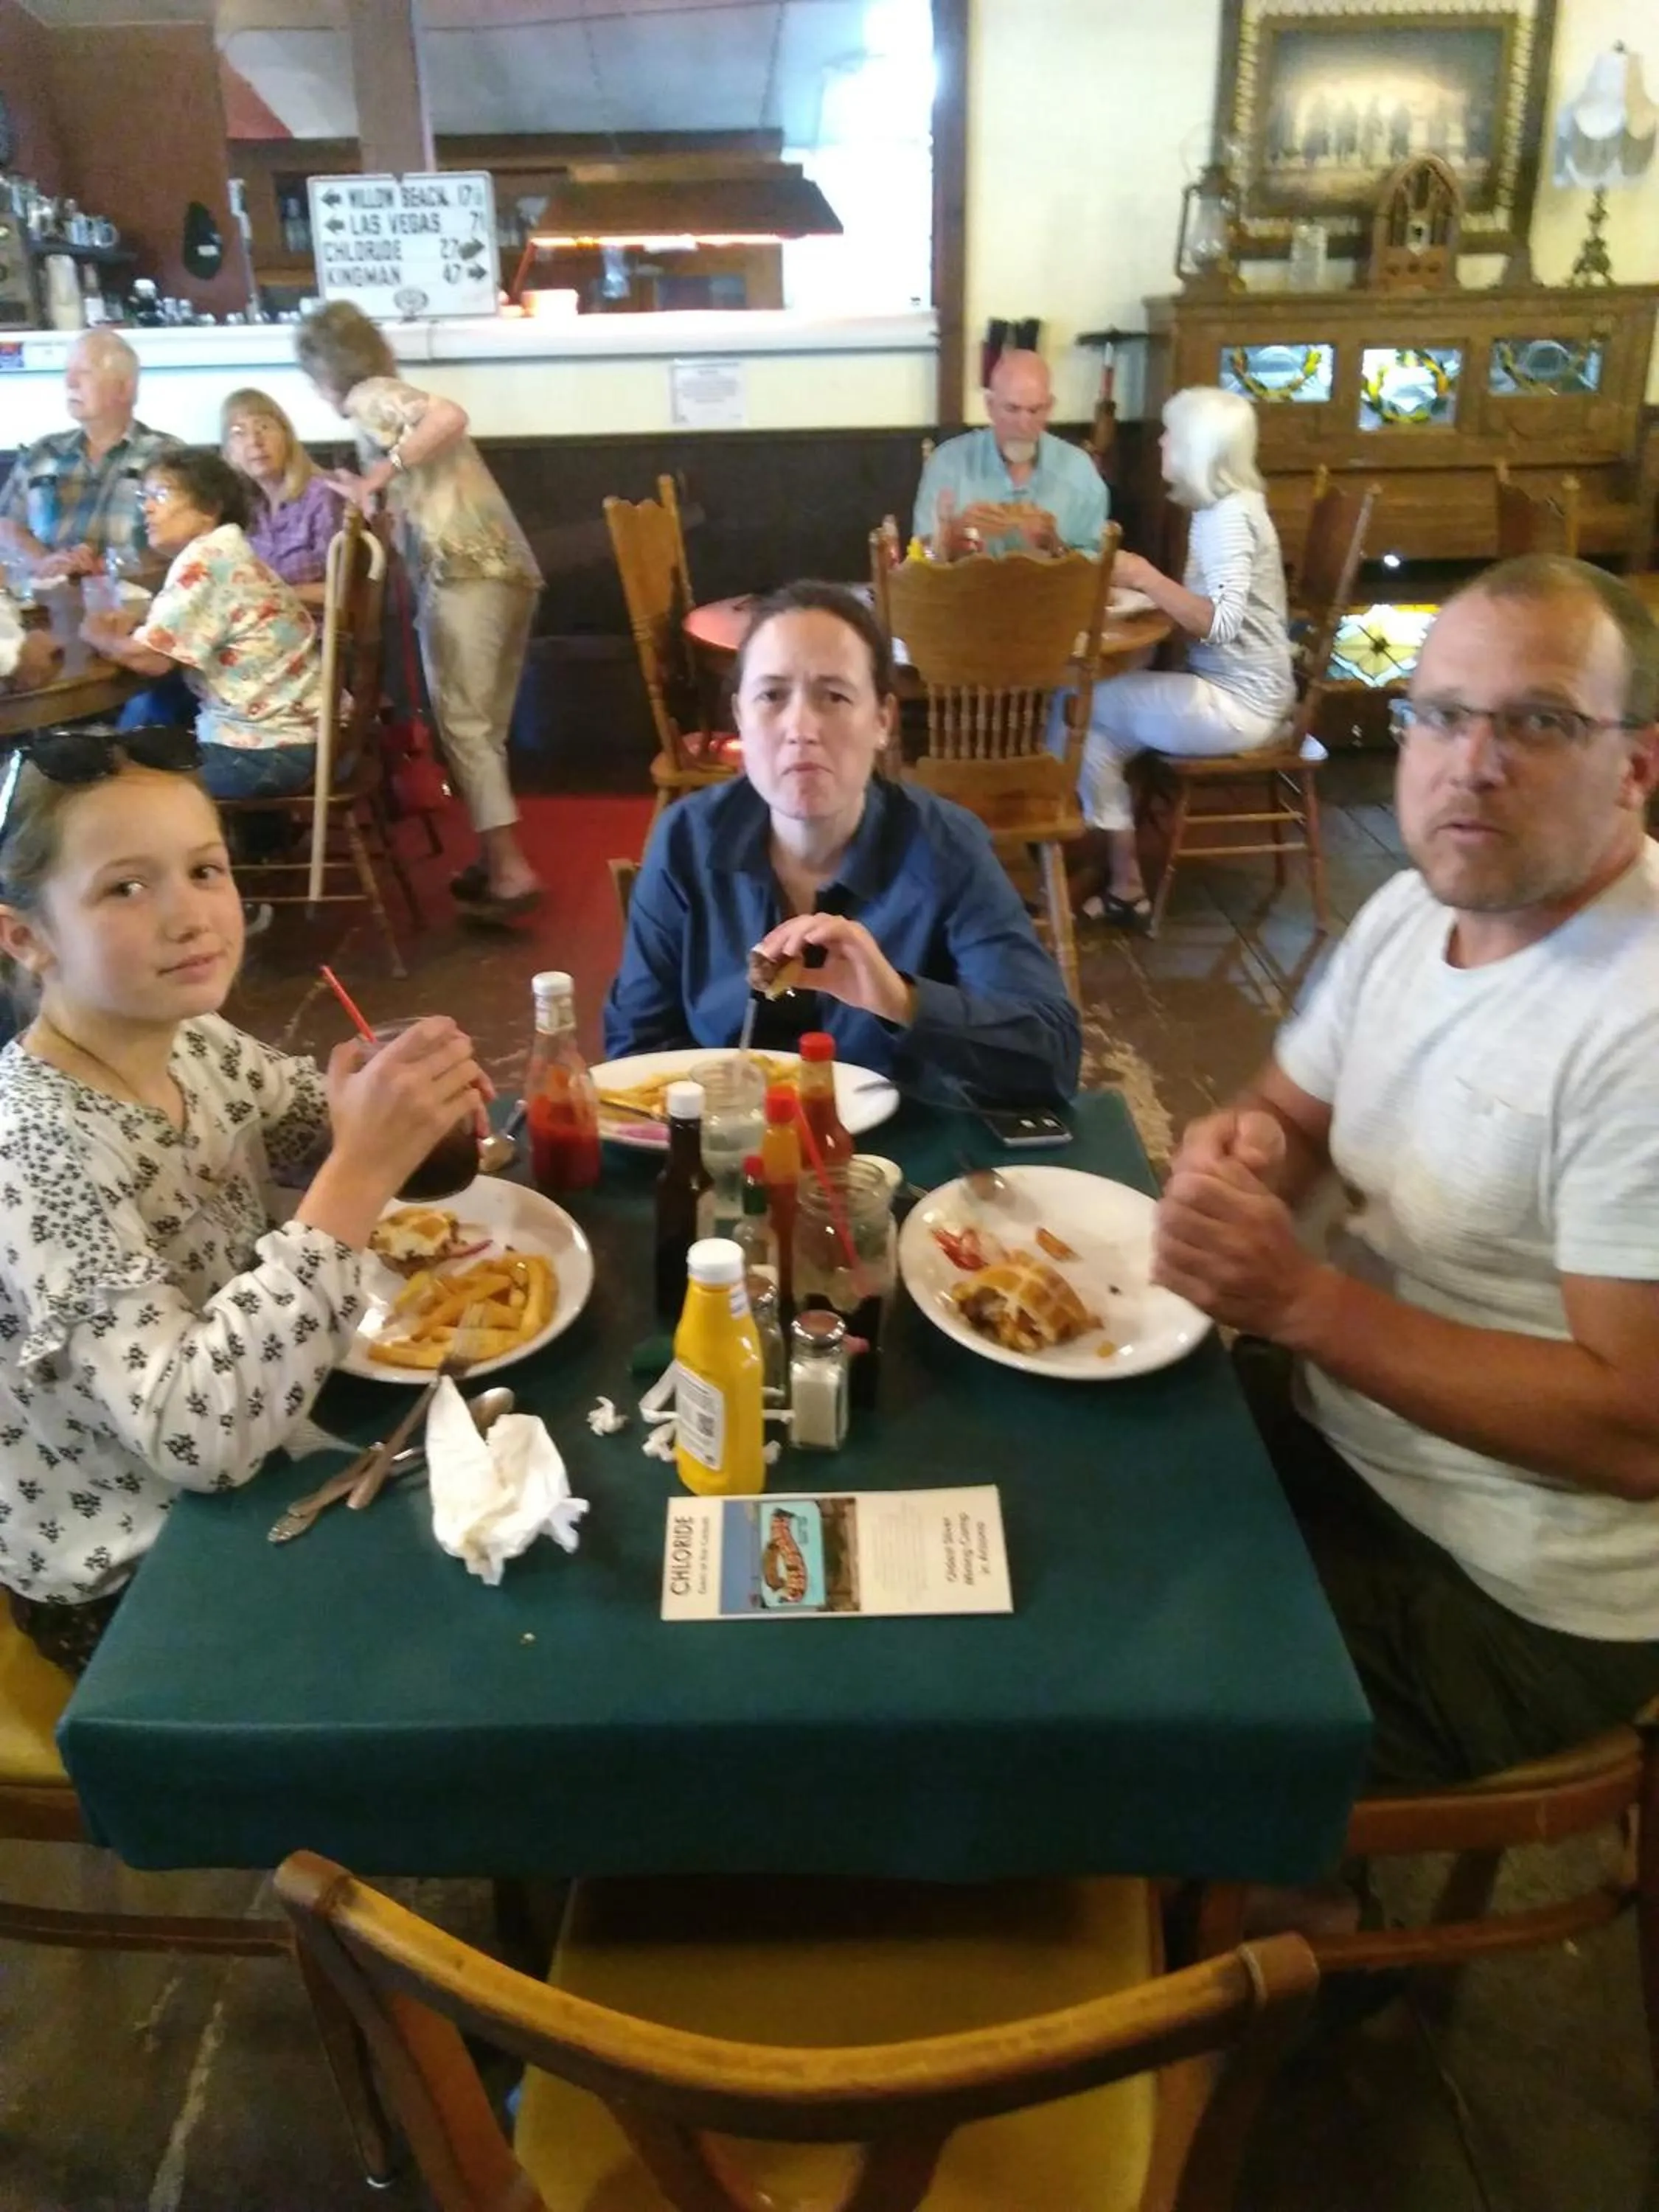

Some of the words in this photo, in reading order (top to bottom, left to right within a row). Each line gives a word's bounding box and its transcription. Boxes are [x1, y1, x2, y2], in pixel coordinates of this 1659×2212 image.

[349, 214, 381, 235] LAS
[388, 212, 441, 234] VEGAS
[323, 240, 403, 262] CHLORIDE
[327, 264, 402, 286] KINGMAN
[670, 1516, 694, 1596] CHLORIDE
